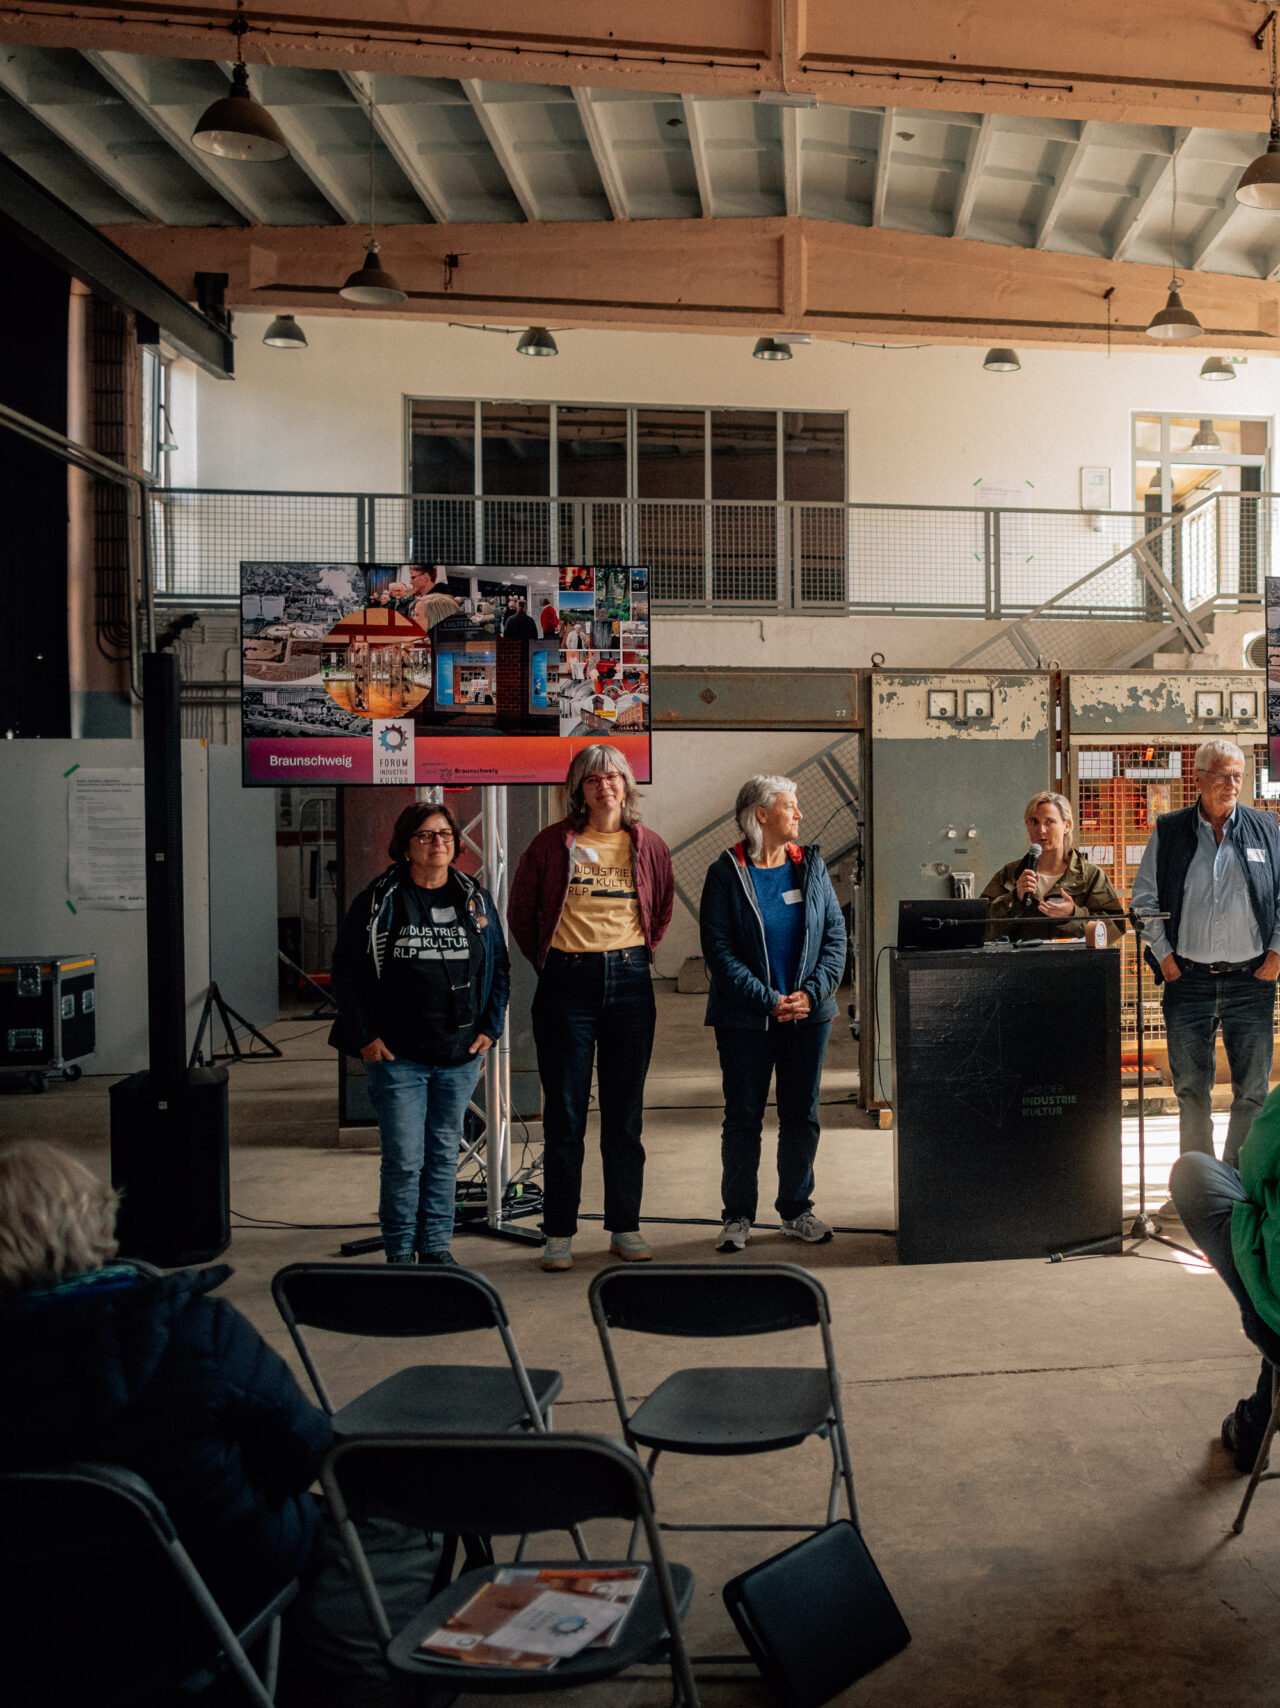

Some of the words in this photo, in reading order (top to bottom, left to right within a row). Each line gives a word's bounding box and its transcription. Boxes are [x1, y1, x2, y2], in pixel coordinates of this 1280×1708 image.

[269, 754, 353, 768] Braunschweig
[379, 758, 409, 767] FORUM
[596, 877, 633, 888] KULTU
[568, 886, 589, 896] RLP
[423, 937, 469, 948] KULTUR
[393, 947, 418, 958] RLP
[1022, 1095, 1077, 1105] INDUSTRIE
[1022, 1106, 1063, 1116] KULTUR
